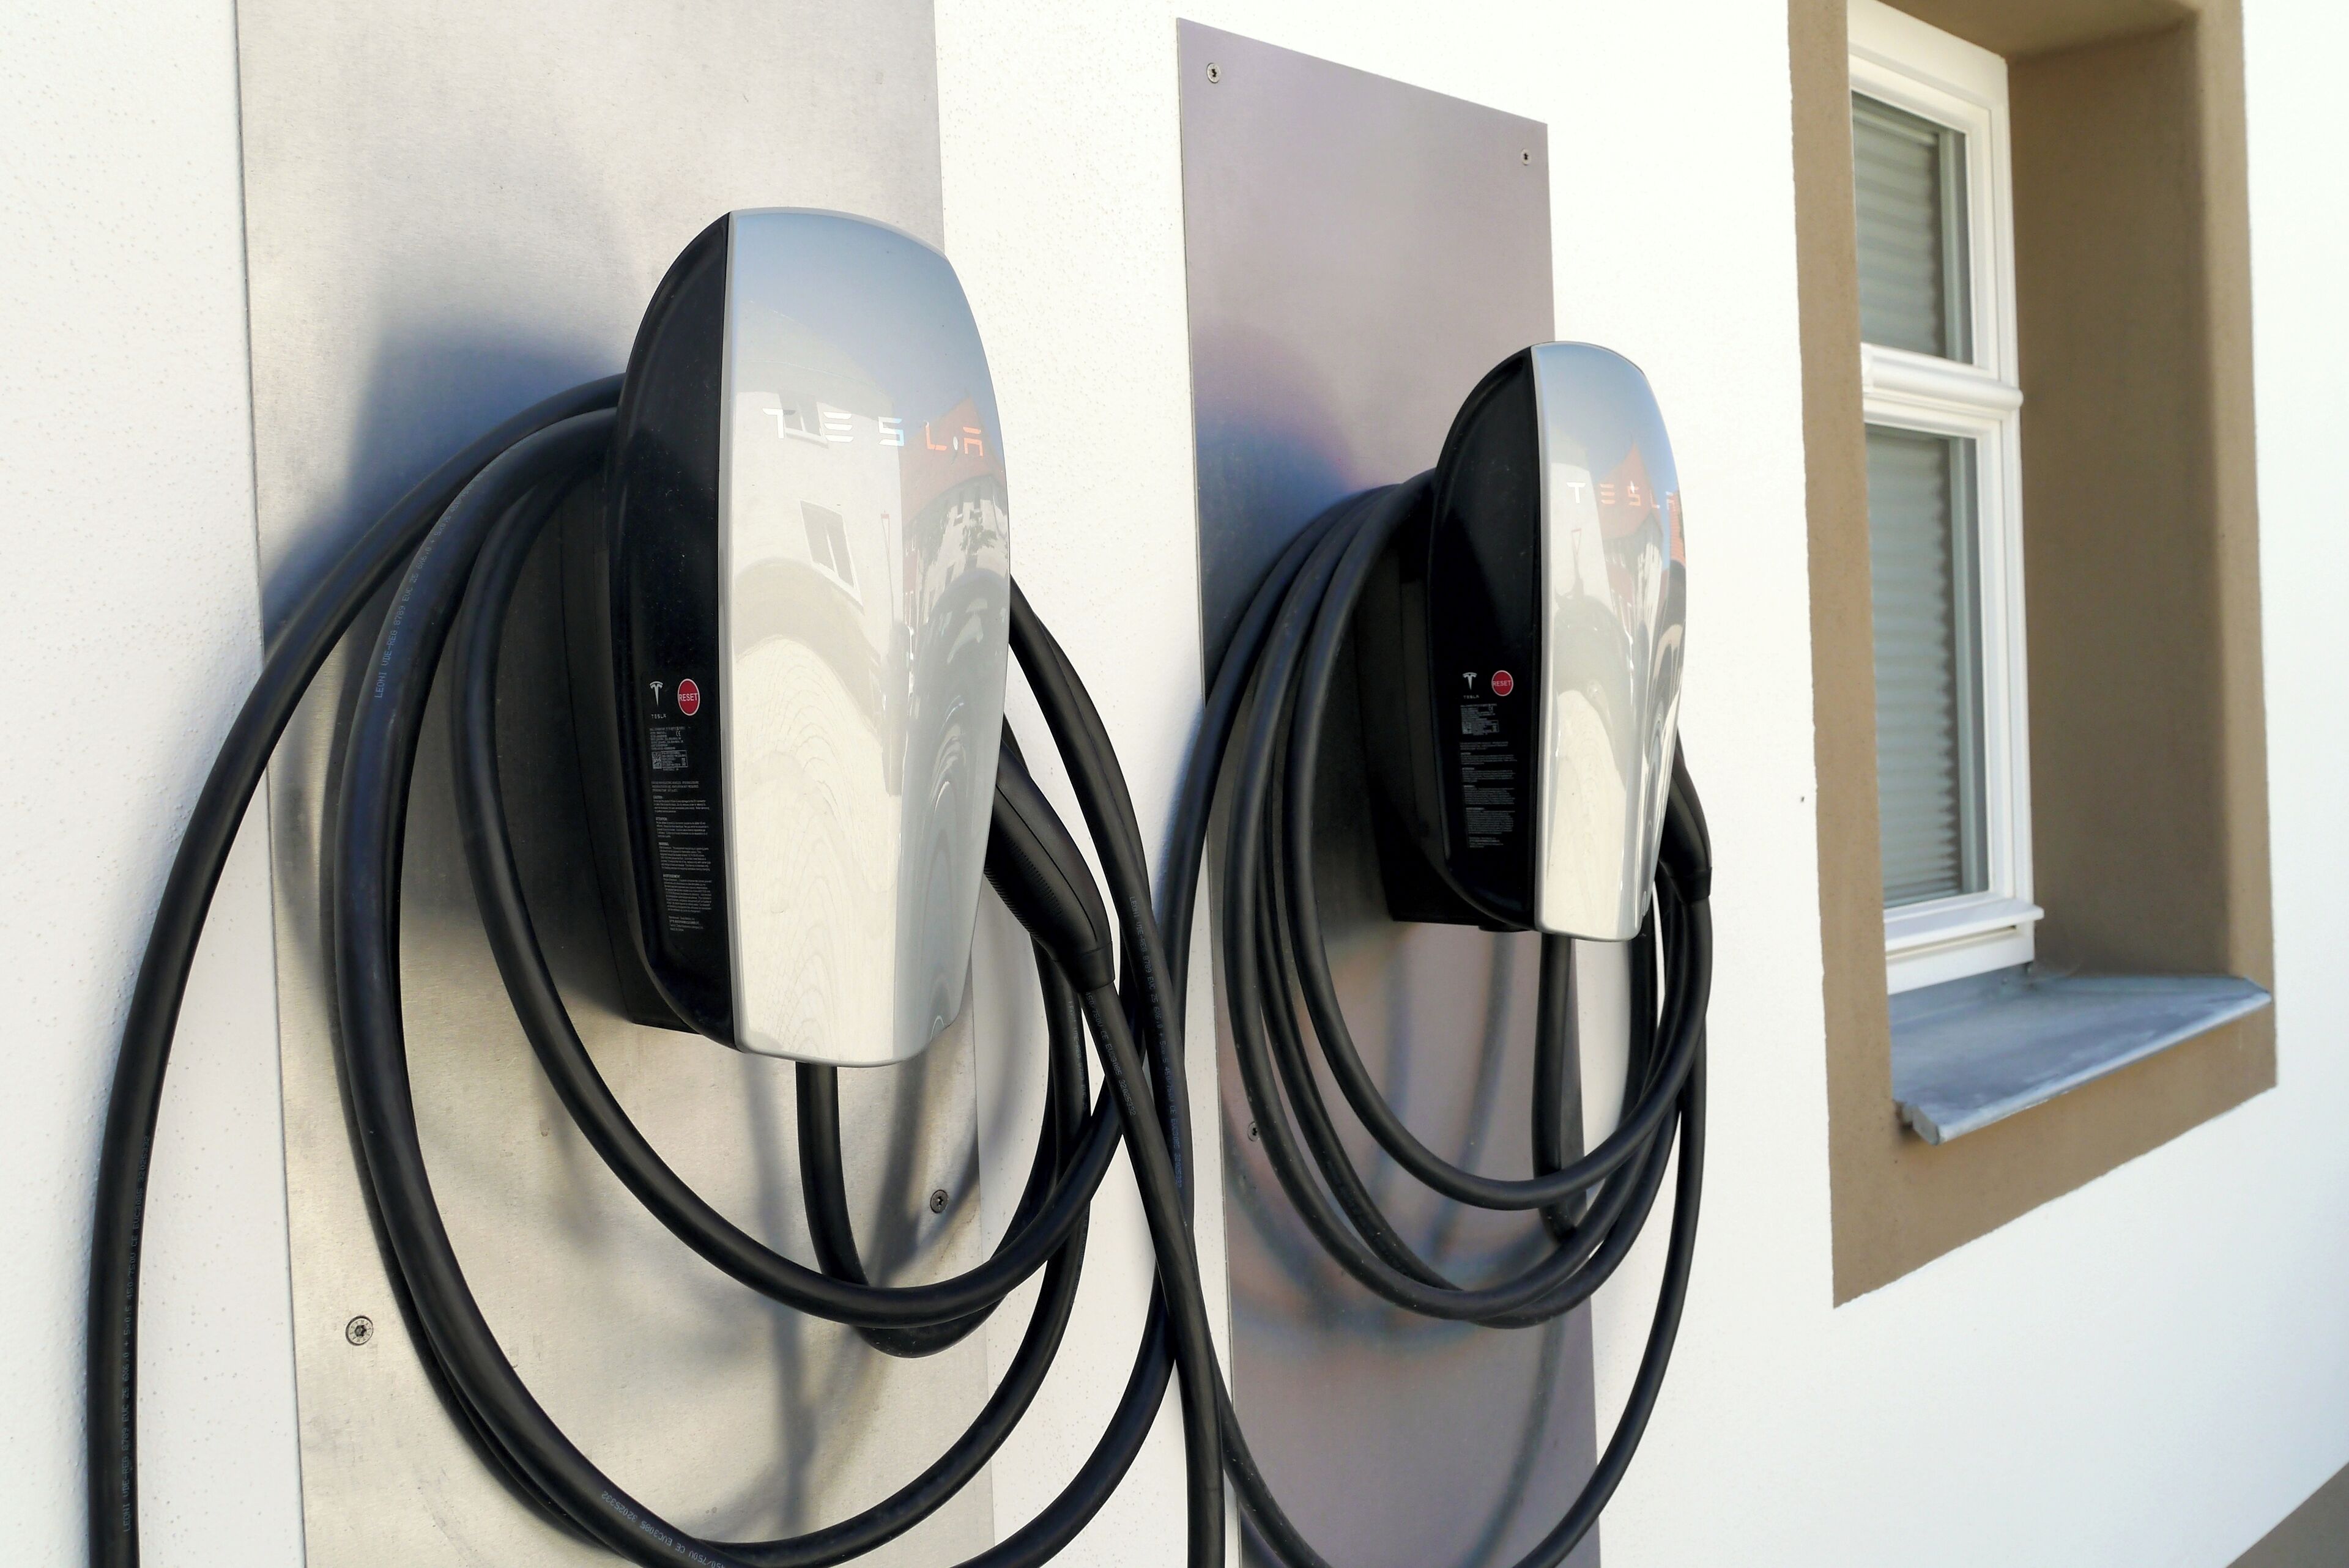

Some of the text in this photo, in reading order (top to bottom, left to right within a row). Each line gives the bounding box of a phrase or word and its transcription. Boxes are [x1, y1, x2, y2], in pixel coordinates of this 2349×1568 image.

[763, 408, 982, 457] TESLA
[1566, 481, 1675, 512] TESLA
[374, 671, 387, 698] LEONI
[678, 693, 699, 701] RESET
[1100, 1030, 1109, 1041] CE
[1118, 1079, 1136, 1115] 32025332
[601, 1490, 638, 1523] 32025332
[675, 1544, 686, 1554] CE
